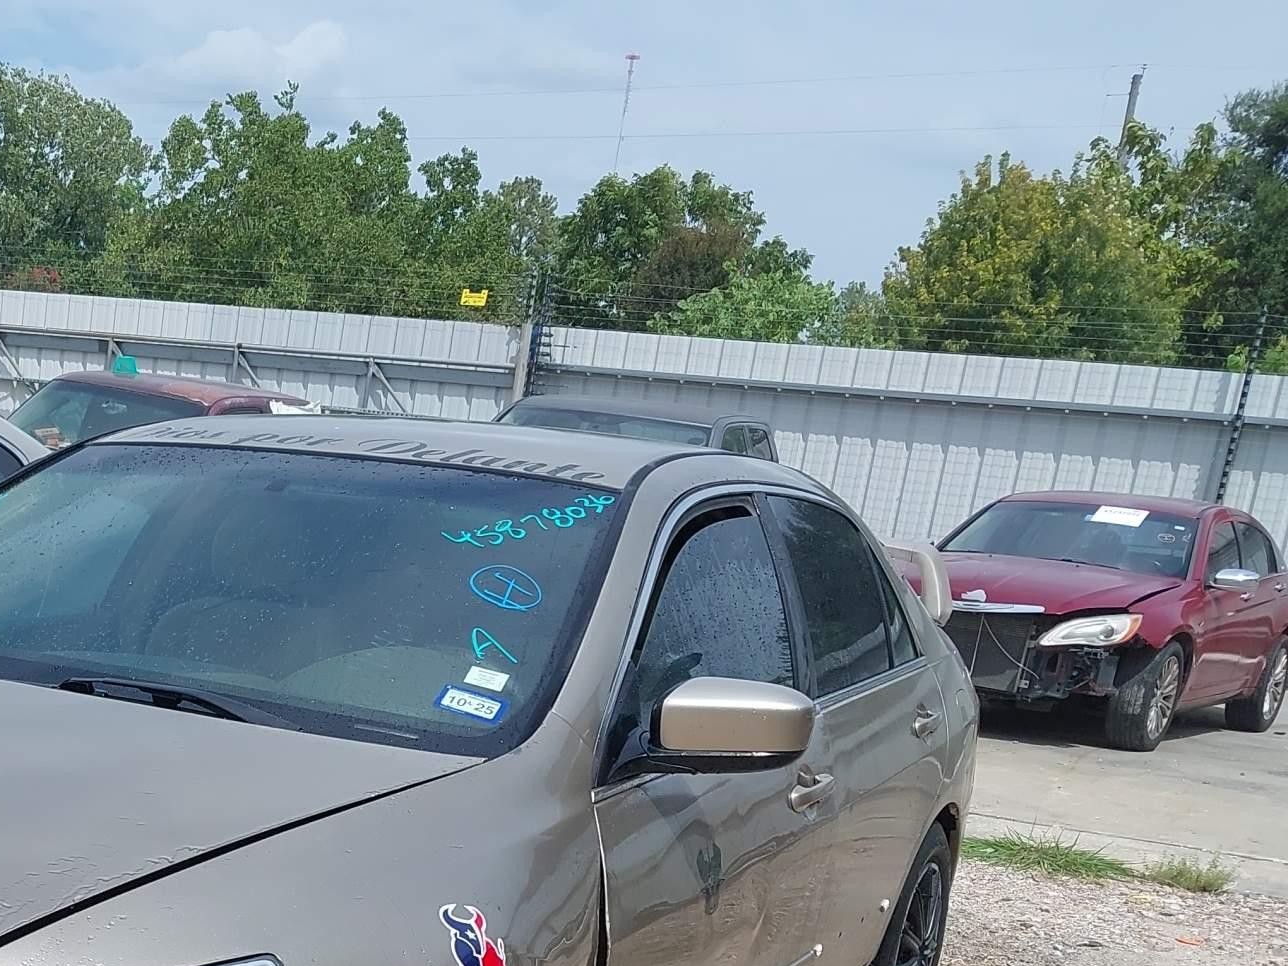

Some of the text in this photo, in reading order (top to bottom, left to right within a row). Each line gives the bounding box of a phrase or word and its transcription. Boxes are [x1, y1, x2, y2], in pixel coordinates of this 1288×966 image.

[229, 431, 345, 446] por
[358, 438, 605, 483] Delante
[440, 494, 616, 548] 45878036
[471, 627, 519, 664] A
[448, 694, 497, 716] 10 25
